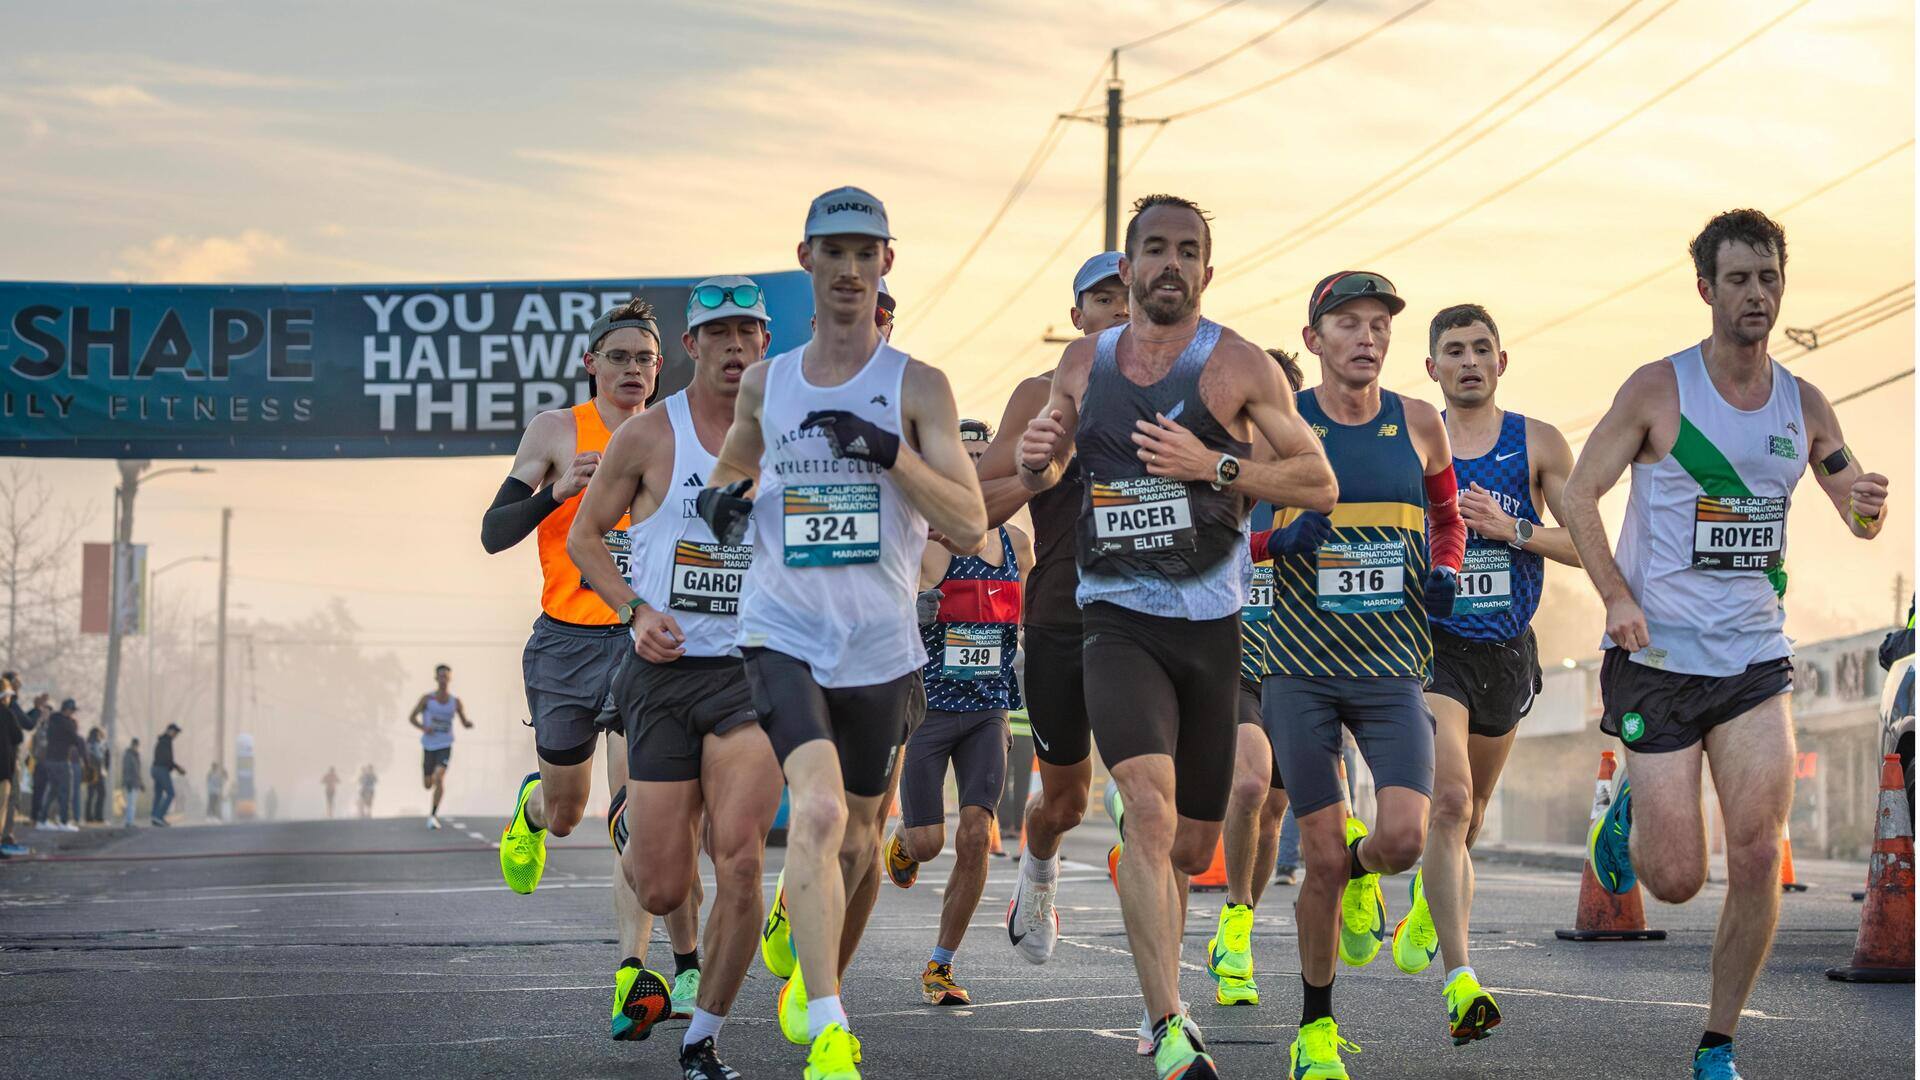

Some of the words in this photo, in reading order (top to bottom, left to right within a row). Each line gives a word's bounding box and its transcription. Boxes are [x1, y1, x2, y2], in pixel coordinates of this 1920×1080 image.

[362, 292, 495, 333] YOU
[108, 393, 312, 421] FITNESS
[364, 380, 593, 432] THER
[774, 459, 839, 475] ATHLETIC
[848, 460, 882, 474] CLUB
[826, 485, 878, 494] CALIFORNIA
[1110, 481, 1129, 489] 2024
[1121, 482, 1185, 496] INTERNATIONAL
[809, 493, 878, 503] INTERNATIONAL
[1139, 489, 1187, 502] MARATHON
[1720, 497, 1740, 505] 2024
[828, 502, 879, 511] MARATHON
[1731, 504, 1784, 513] INTERNATIONAL
[1106, 506, 1176, 532] PACER
[1748, 511, 1784, 521] MARATHON
[805, 516, 858, 542] 324
[1134, 534, 1174, 550] ELITE
[1710, 527, 1774, 547] ROYER
[1358, 542, 1403, 551] CALIFORNIA
[832, 549, 880, 559] MARATHON
[1343, 550, 1403, 559] INTERNATIONAL
[1466, 549, 1510, 557] CALIFORNIA
[1360, 557, 1403, 565] MARATHON
[1469, 562, 1509, 570] MARATHON
[1733, 555, 1768, 567] ELITE
[1338, 569, 1384, 593] 316
[1363, 598, 1403, 607] MARATHON
[1472, 600, 1511, 608] MARATHON
[960, 648, 990, 665] 349
